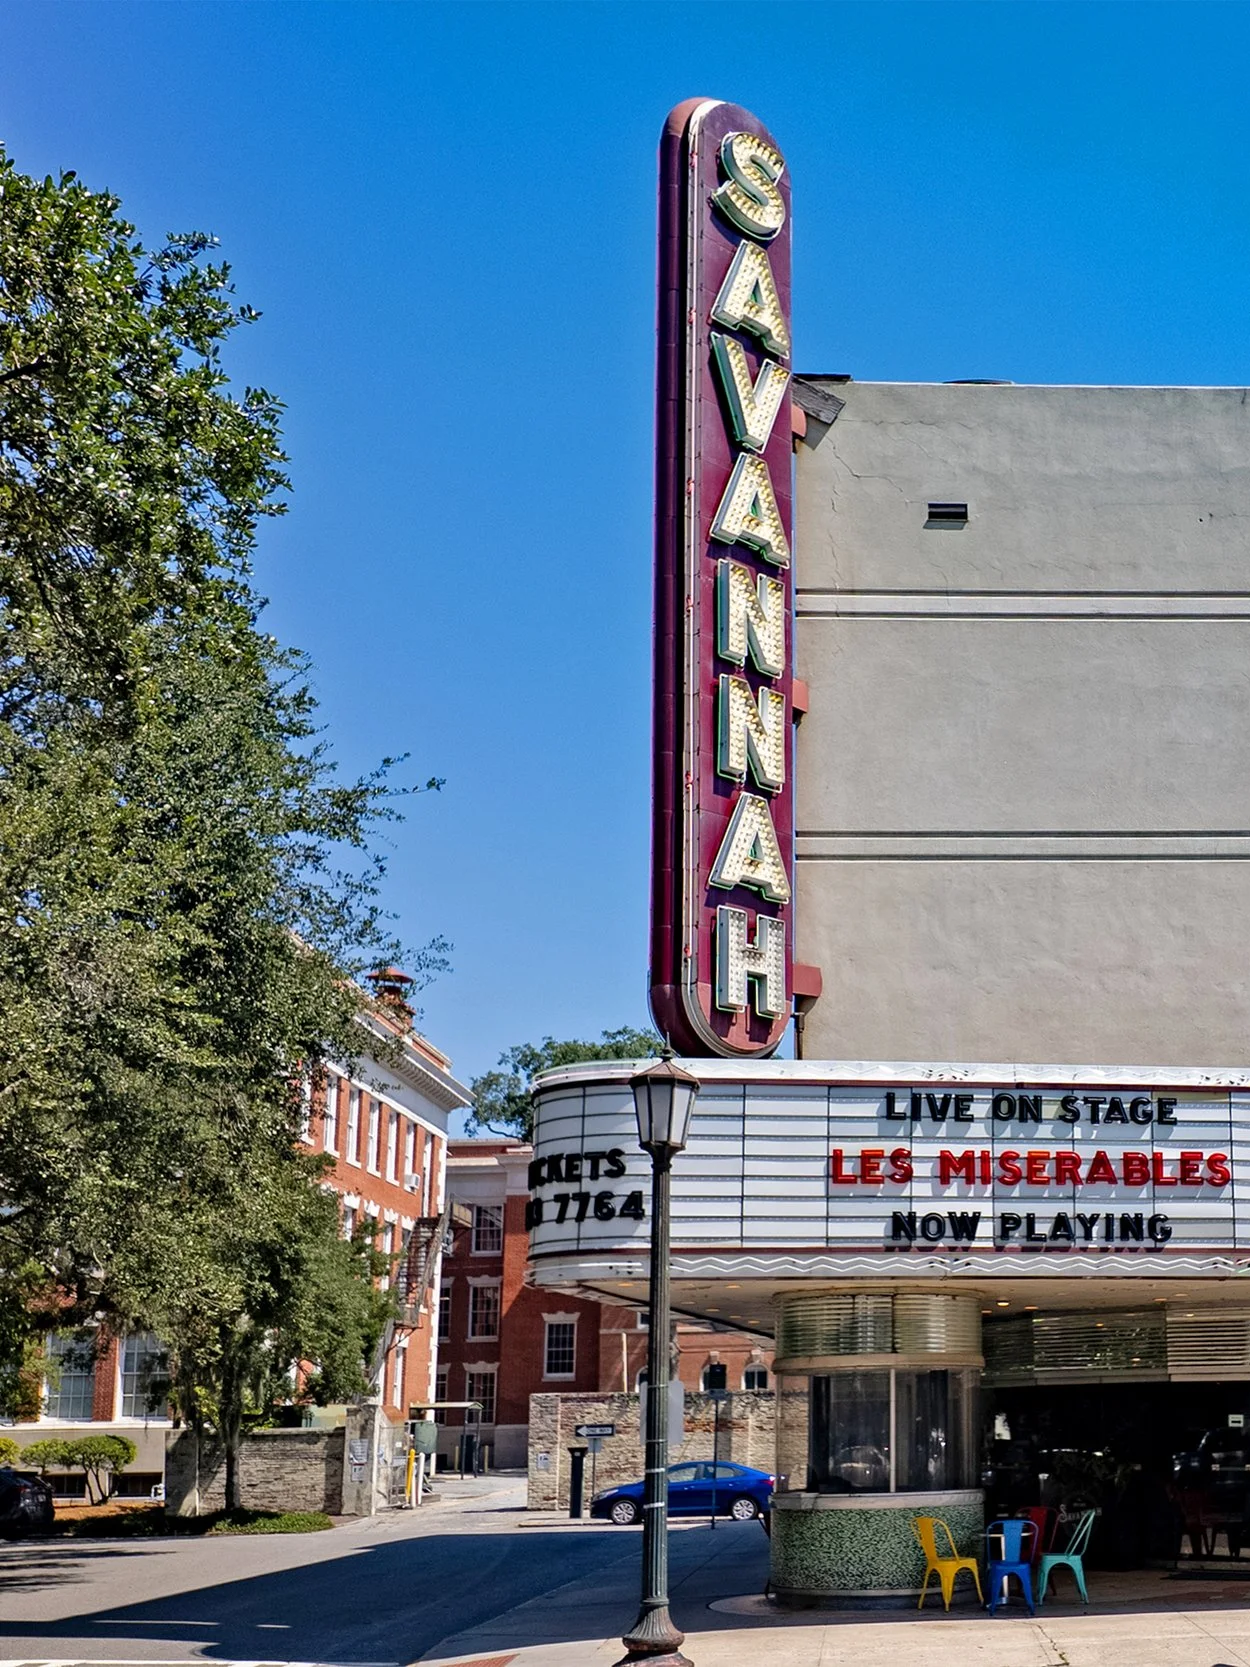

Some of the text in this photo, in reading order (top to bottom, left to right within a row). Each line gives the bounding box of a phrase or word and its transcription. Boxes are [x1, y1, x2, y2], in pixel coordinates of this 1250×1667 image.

[710, 130, 791, 1022] SAVANNAH
[885, 1092, 1178, 1126] LIVE ON STAGE
[831, 1148, 1231, 1187] LES MISERABLES
[553, 1191, 646, 1224] 7764
[891, 1211, 1174, 1243] NOW PLAYING
